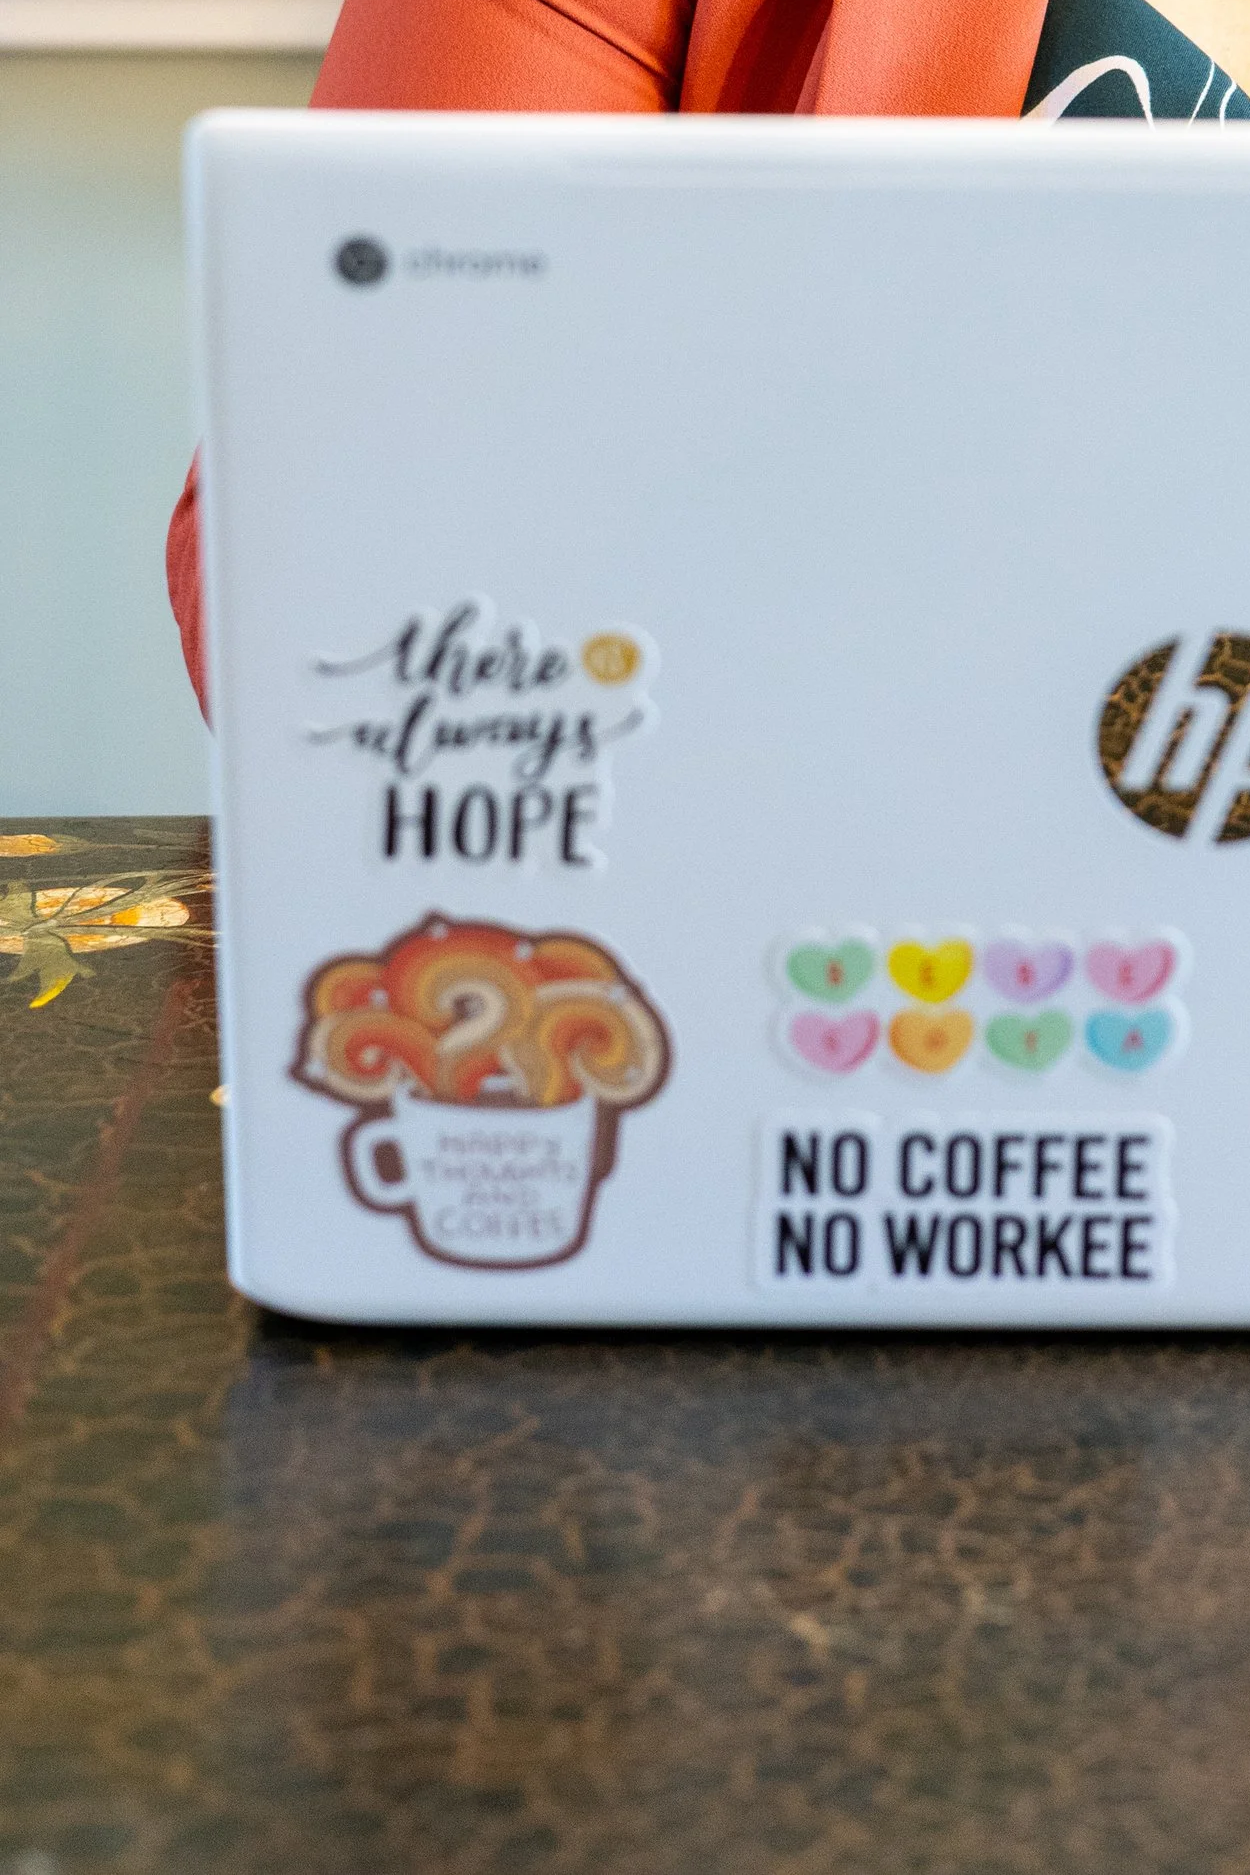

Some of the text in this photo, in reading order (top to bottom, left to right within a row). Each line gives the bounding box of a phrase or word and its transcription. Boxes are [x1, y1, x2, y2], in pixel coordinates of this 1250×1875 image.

[315, 600, 569, 696] there
[306, 691, 644, 781] always
[383, 780, 600, 865] HOPE
[780, 1129, 1152, 1202] NO COFFEE
[774, 1208, 1155, 1282] NO WORKEE
